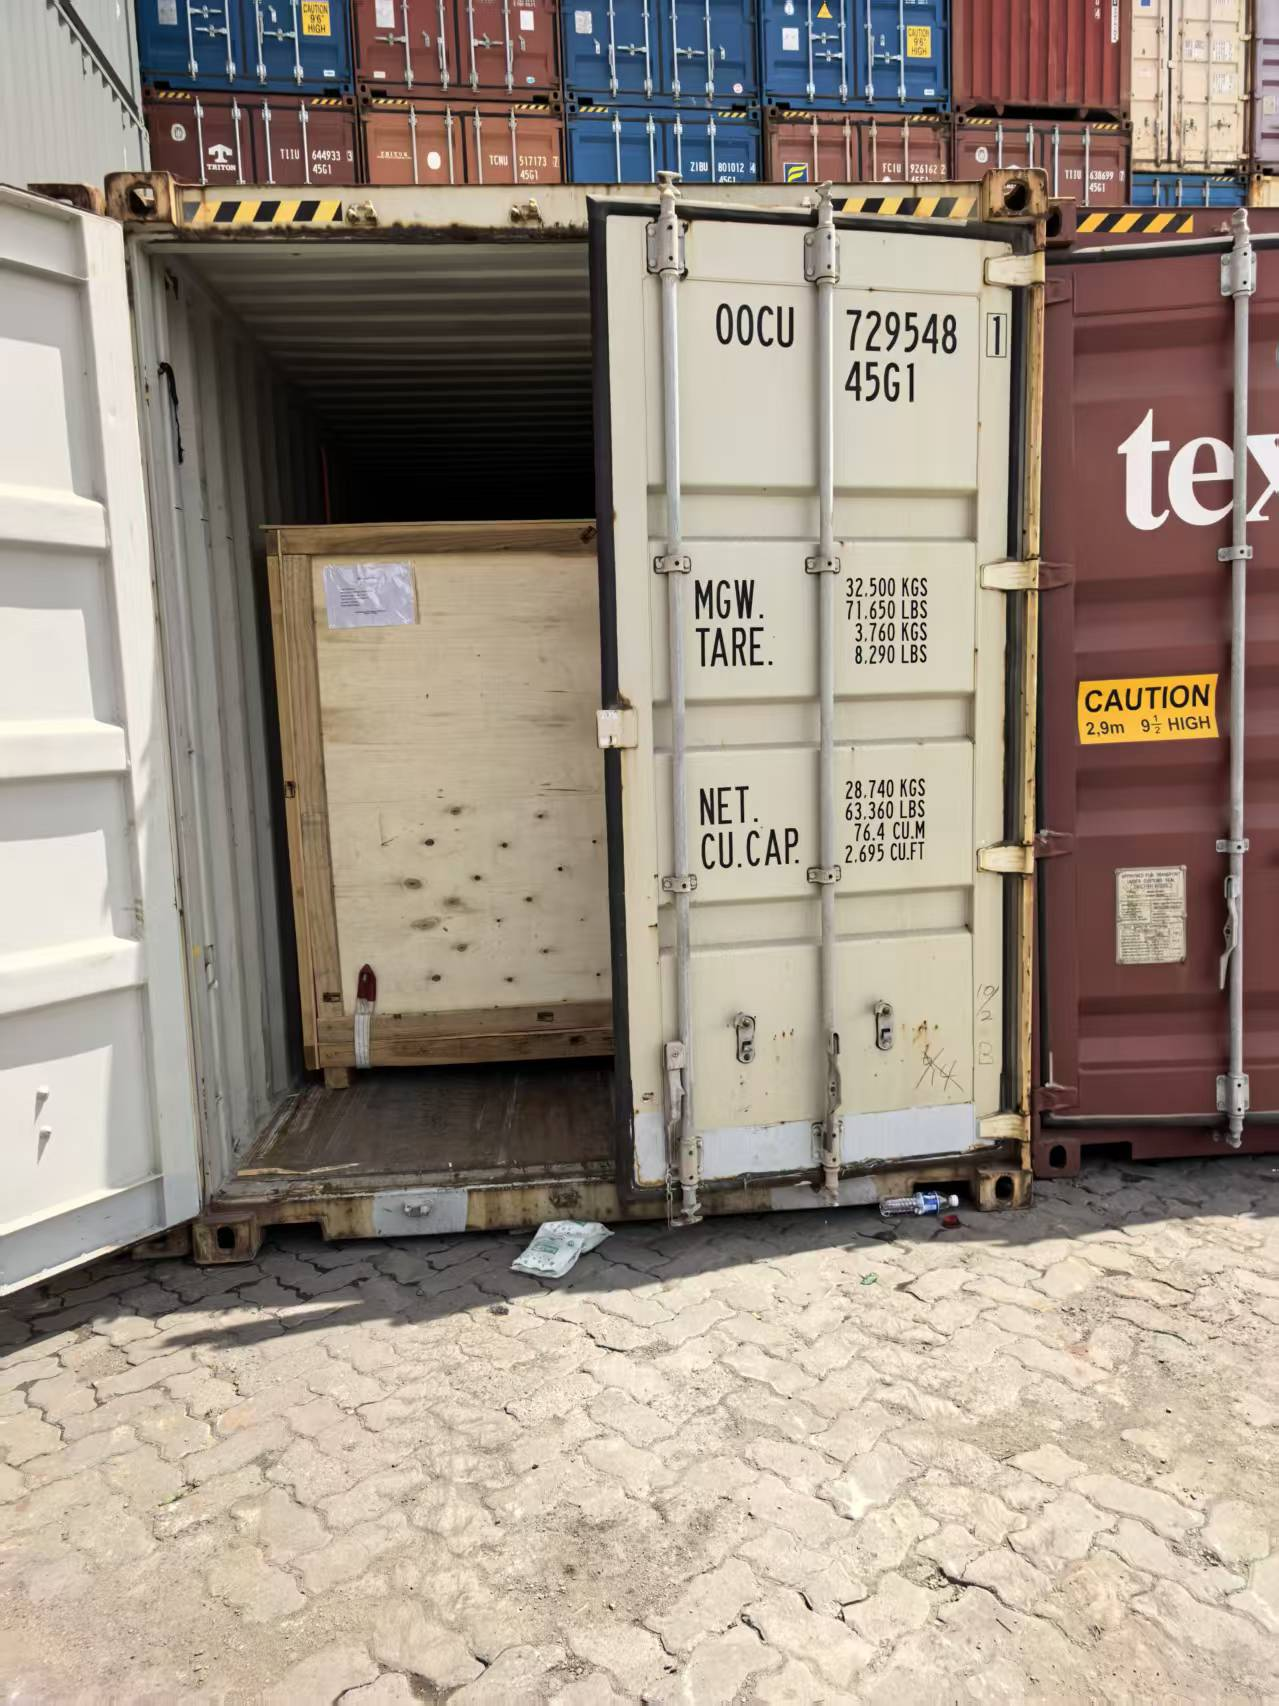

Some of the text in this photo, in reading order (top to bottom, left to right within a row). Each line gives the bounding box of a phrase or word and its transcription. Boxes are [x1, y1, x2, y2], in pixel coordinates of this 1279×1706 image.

[303, 4, 328, 14] CAUTION
[308, 24, 326, 33] HIGH
[908, 28, 930, 37] CAUTION
[912, 47, 928, 55] HIGH
[312, 150, 341, 161] 644933
[489, 155, 508, 166] TCNU
[519, 156, 547, 167] 517173
[206, 163, 236, 171] TRITON
[312, 164, 332, 175] 45G1
[520, 170, 538, 180] 45G1
[718, 162, 745, 173] 801012
[882, 163, 946, 174] FCIU 926162 2
[1089, 182, 1105, 192] 45G1
[845, 310, 958, 355] 729548
[845, 361, 916, 403] 45G1
[846, 577, 928, 597] 32.500 KGS
[694, 579, 764, 620] MGW.
[846, 600, 928, 620] 71.650 LBS
[855, 622, 927, 642] 3.760 KGS
[695, 627, 774, 667] TARE.
[854, 645, 927, 664] 8.290 LBS
[1084, 683, 1210, 713] CAUTION
[1168, 715, 1211, 731] HIGH
[845, 778, 926, 800] 28.740 KGS
[699, 785, 759, 825] NET.
[845, 801, 925, 821] 63.360 LBS
[854, 822, 925, 842] 76.4 CU.M
[701, 828, 800, 870] CU.CAP.
[845, 841, 924, 864] 2.695 CU.FT
